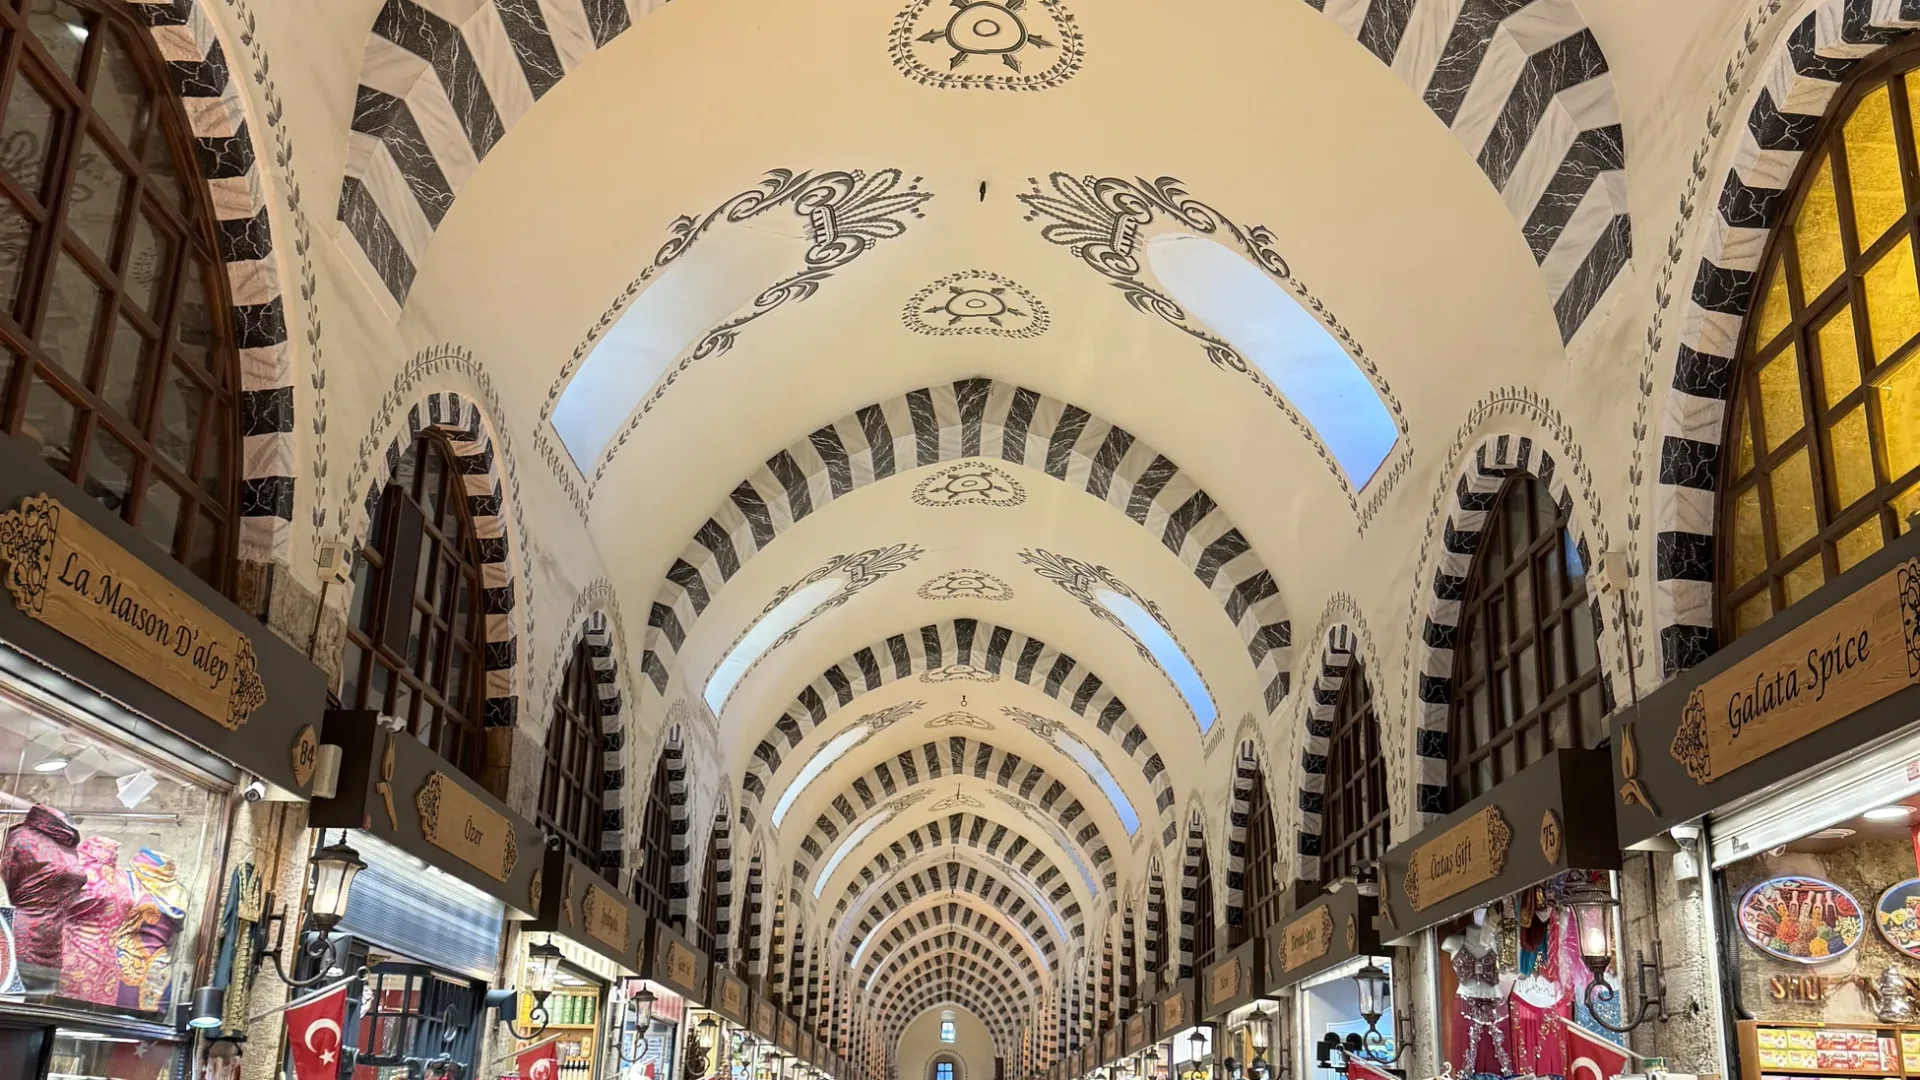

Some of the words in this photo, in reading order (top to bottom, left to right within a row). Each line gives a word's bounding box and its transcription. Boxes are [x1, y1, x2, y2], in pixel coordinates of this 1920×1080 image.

[57, 551, 89, 596] La
[1728, 669, 1800, 738] Galata
[1807, 630, 1870, 702] Spice
[300, 739, 315, 770] 84
[464, 814, 484, 847] Özer
[1543, 823, 1556, 851] 75
[1455, 836, 1472, 875] Gift
